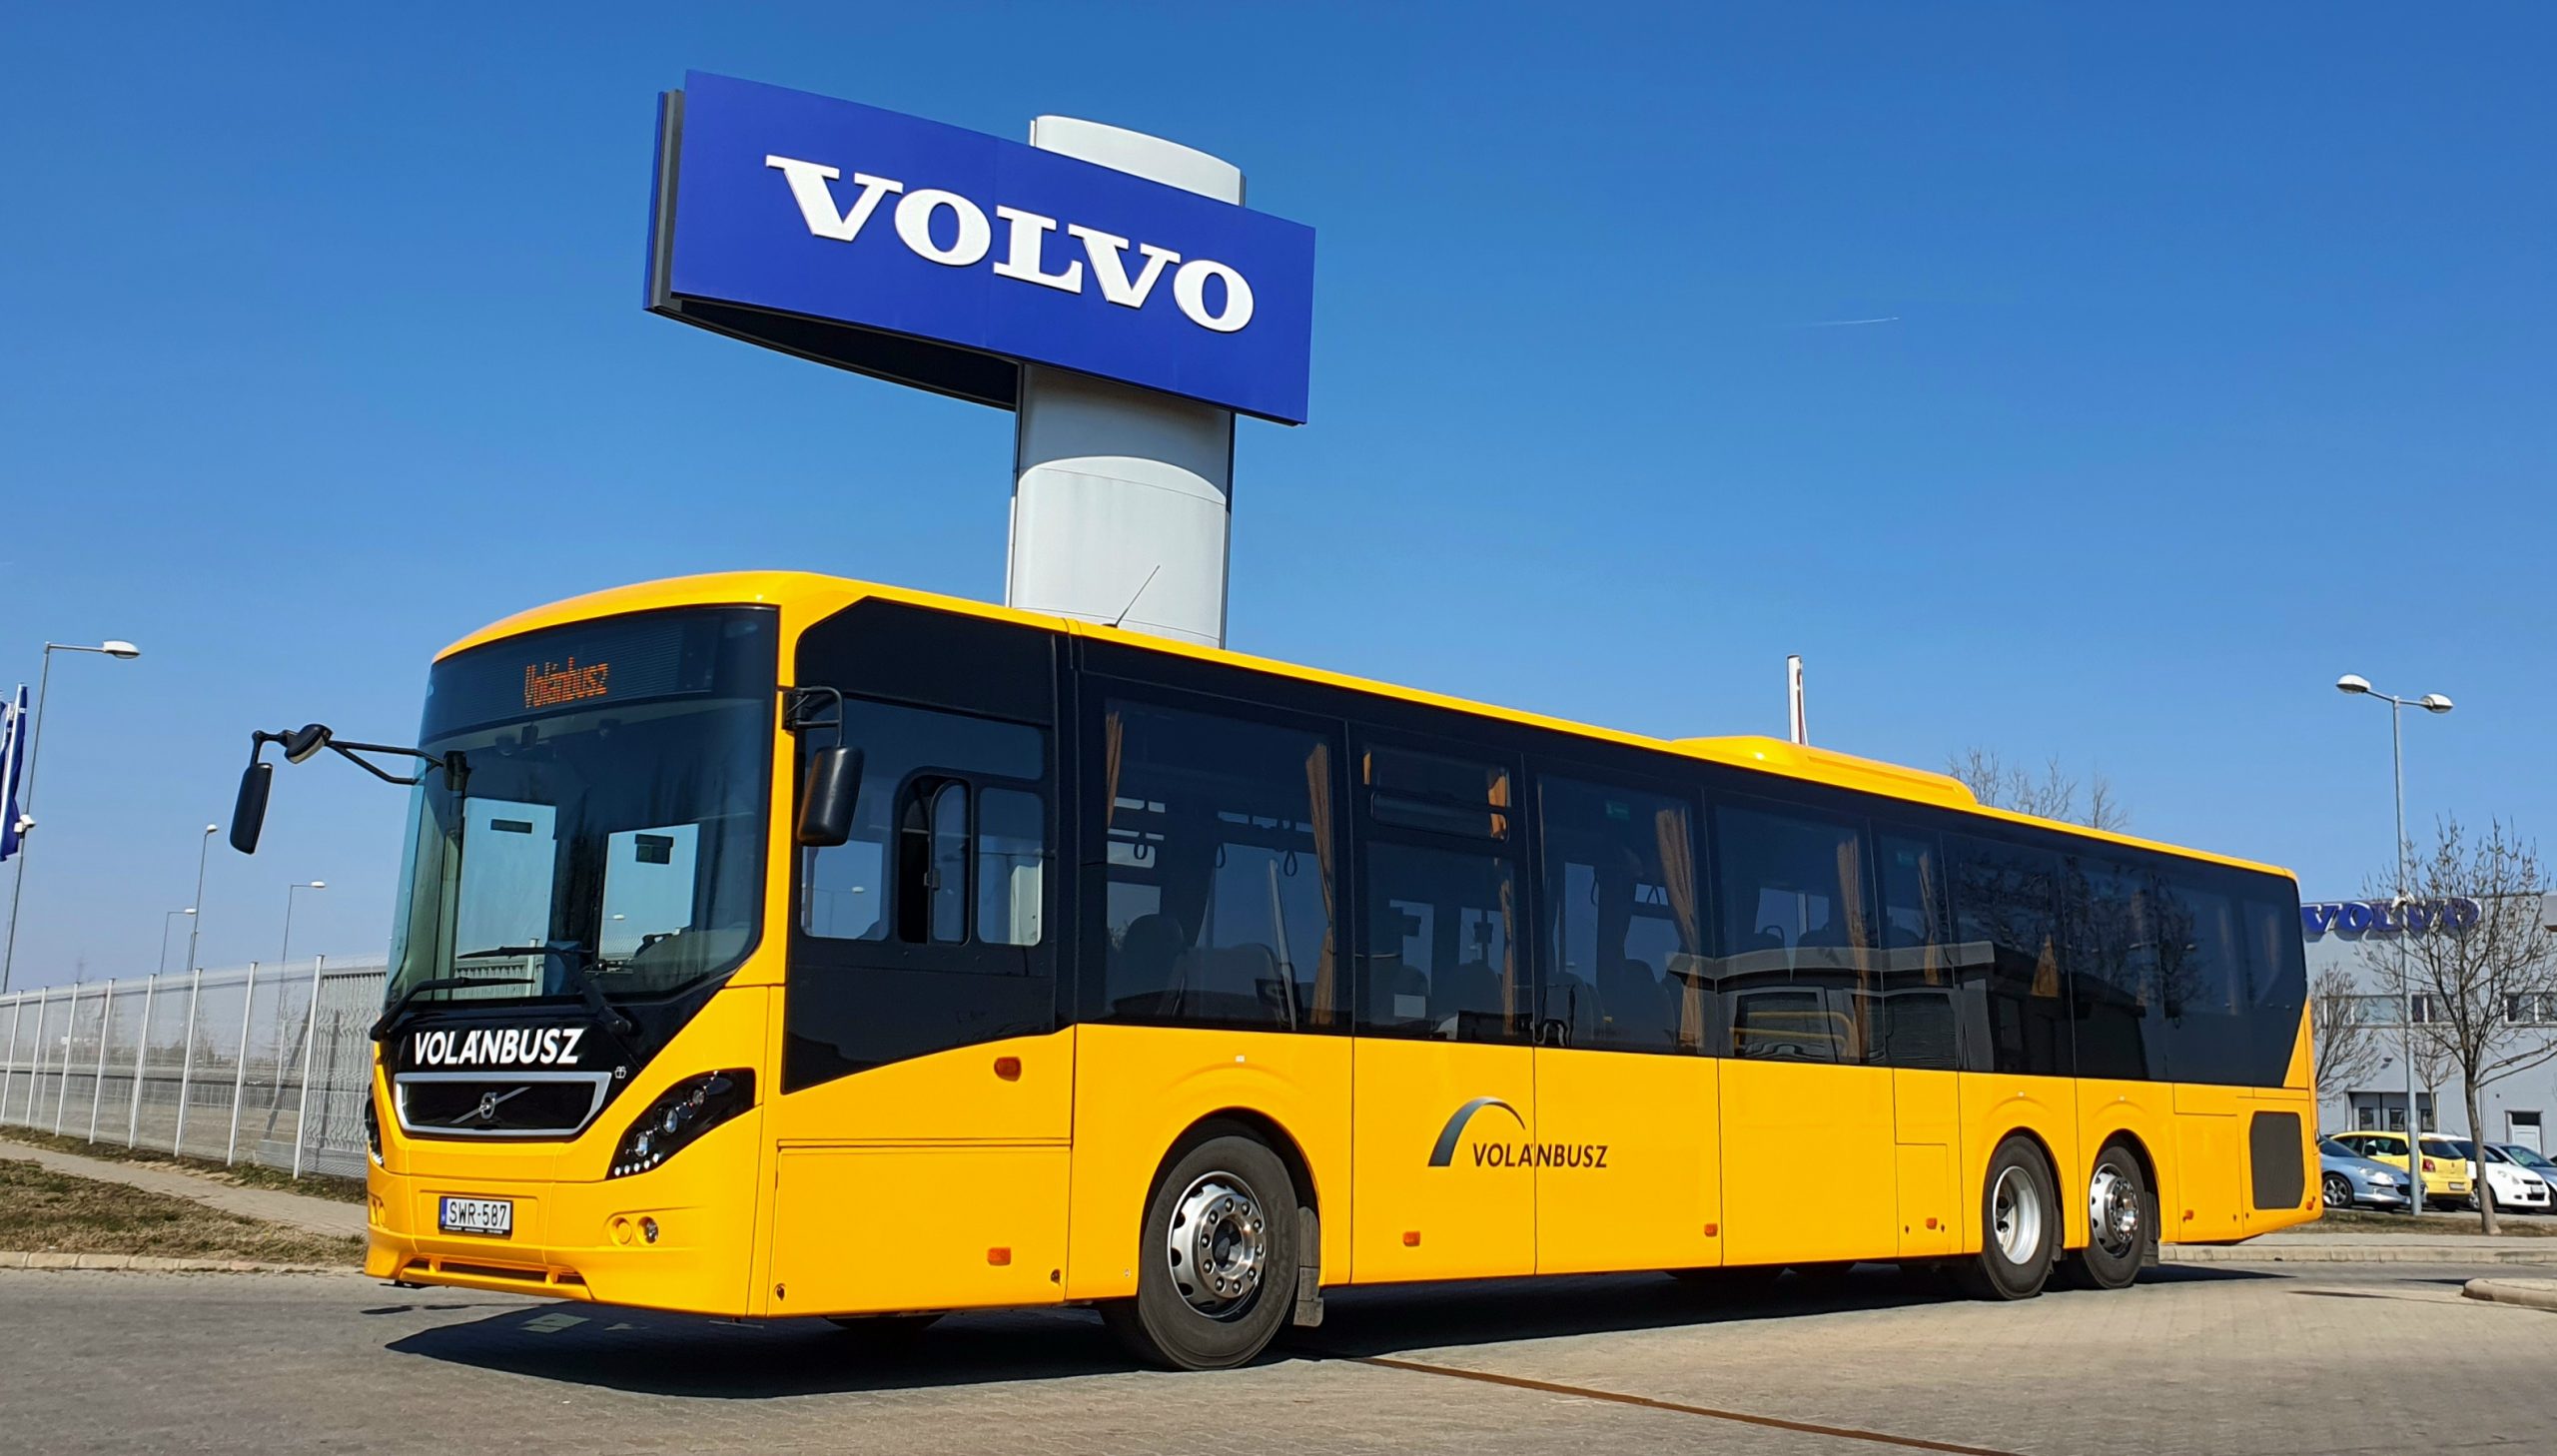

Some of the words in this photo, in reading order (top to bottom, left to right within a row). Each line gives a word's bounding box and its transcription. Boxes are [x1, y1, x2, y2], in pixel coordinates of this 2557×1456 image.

[764, 154, 1256, 334] VOLVO
[2300, 897, 2482, 933] VOLVO
[415, 1028, 585, 1066] VOLÁNBUSZ
[1472, 1142, 1609, 1168] VOLÁNBUSZ
[449, 1201, 507, 1227] SWR-587
